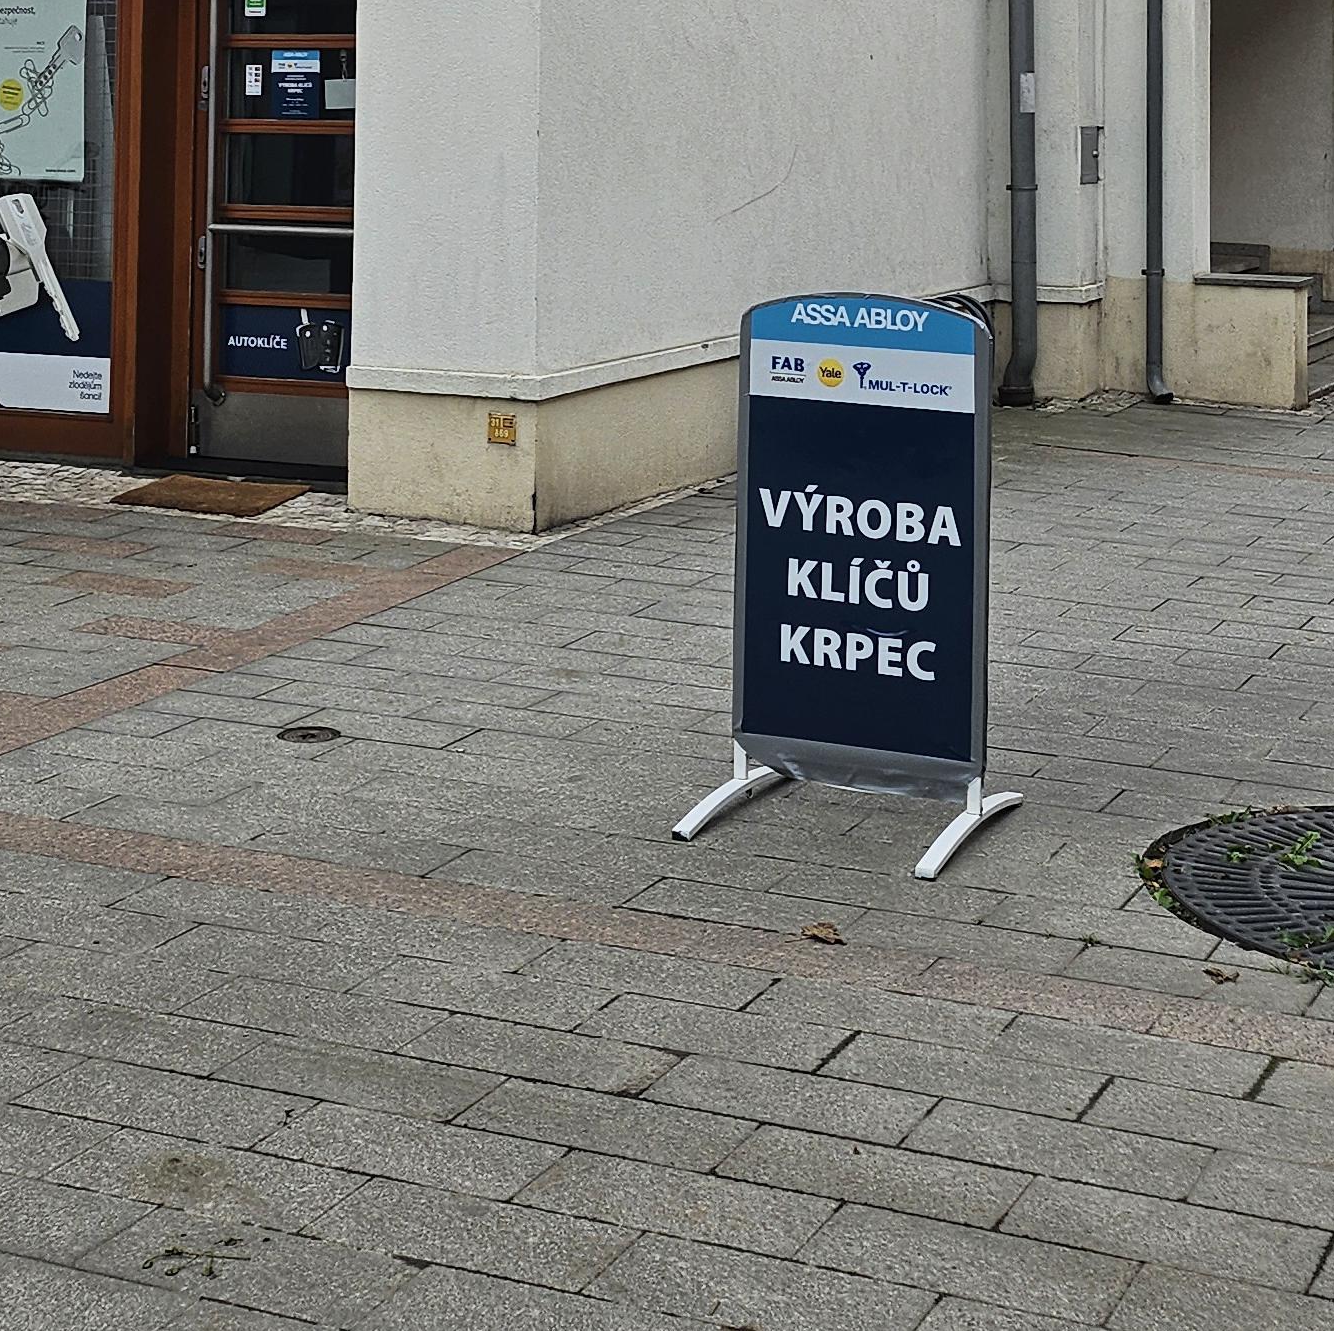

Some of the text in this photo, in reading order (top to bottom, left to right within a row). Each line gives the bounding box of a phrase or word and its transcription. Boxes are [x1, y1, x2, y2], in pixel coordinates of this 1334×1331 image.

[791, 302, 929, 333] ASSA ABLOY
[227, 334, 288, 350] AUTOKLÍČE
[771, 355, 804, 373] FAB
[819, 365, 842, 381] Yale
[868, 379, 949, 397] MUL-T-LOCK
[758, 484, 962, 547] VÝROBA
[787, 557, 929, 613] KLÍČŮ
[780, 623, 936, 682] KRPEC
